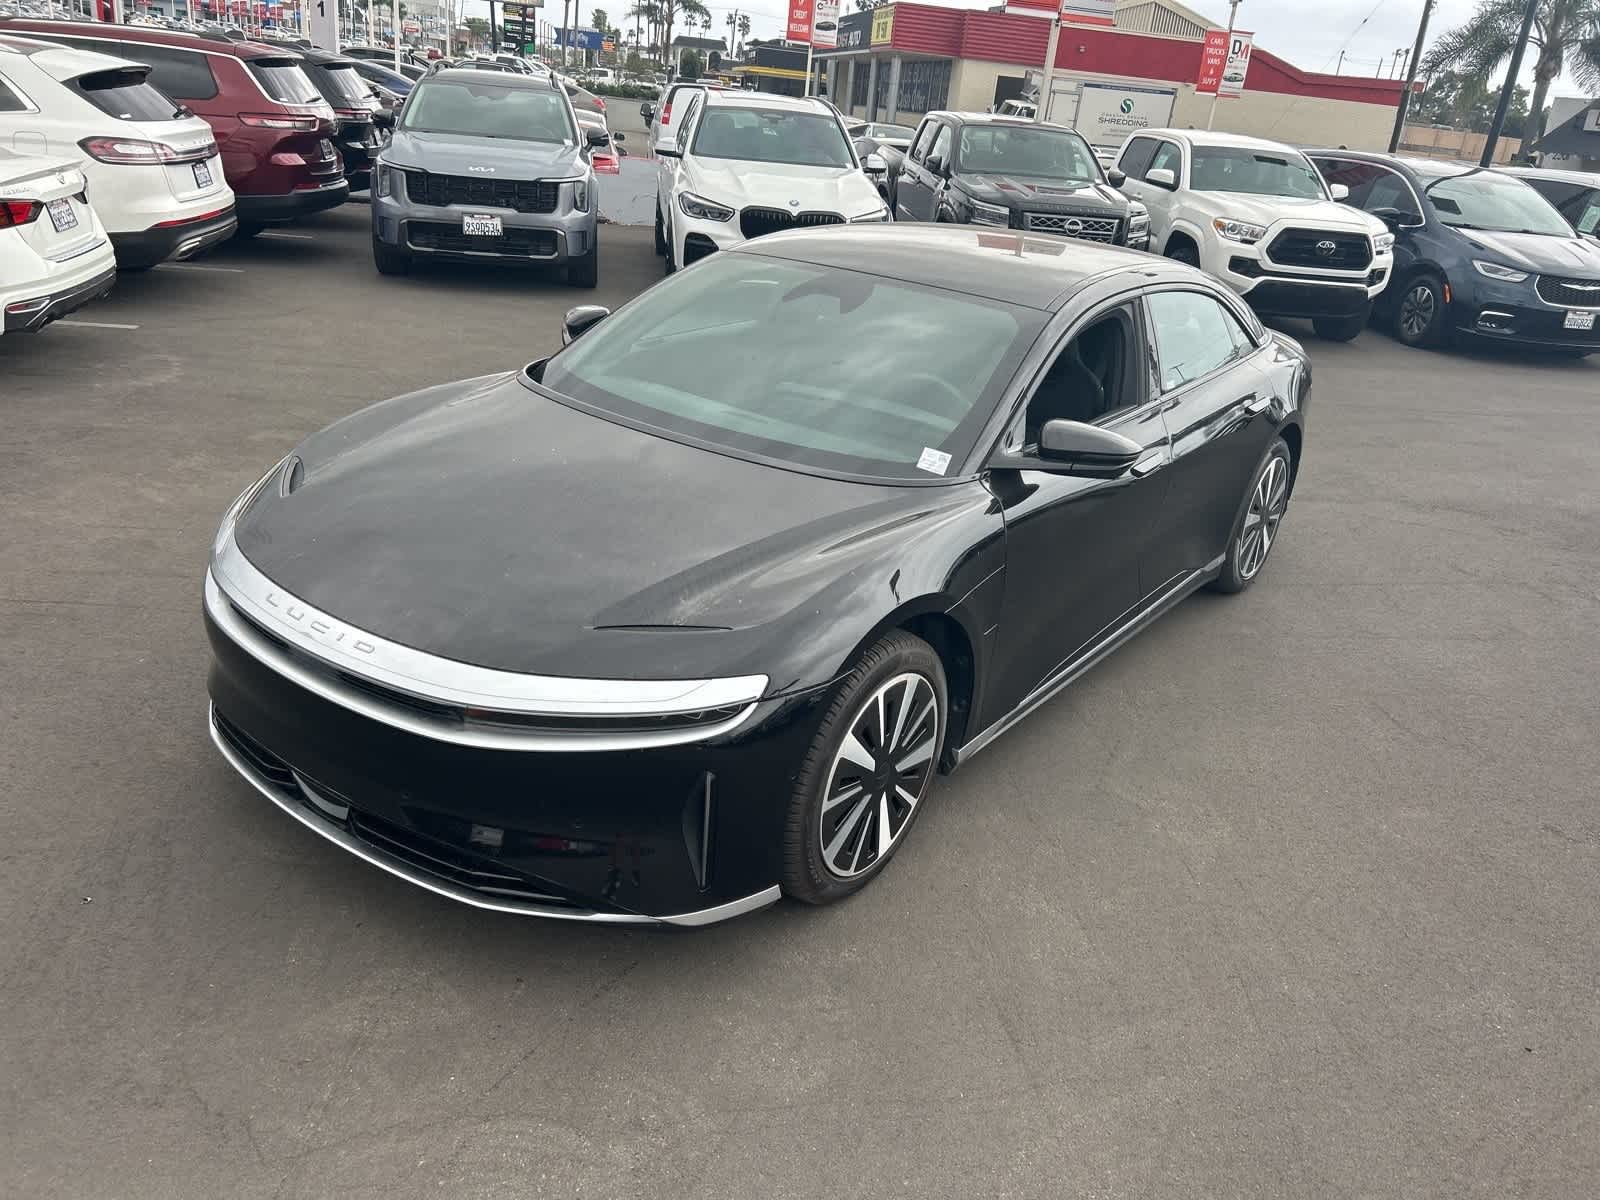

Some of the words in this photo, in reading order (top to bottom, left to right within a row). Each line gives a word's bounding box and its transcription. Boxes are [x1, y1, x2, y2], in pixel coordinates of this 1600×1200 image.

[317, 1, 325, 17] 1
[790, 23, 809, 33] WELCOME
[1210, 37, 1224, 45] CARS
[1206, 47, 1225, 56] TRUCKS
[1207, 57, 1220, 65] VANS
[1098, 116, 1149, 128] SHREDDING
[265, 593, 376, 654] LUCID
